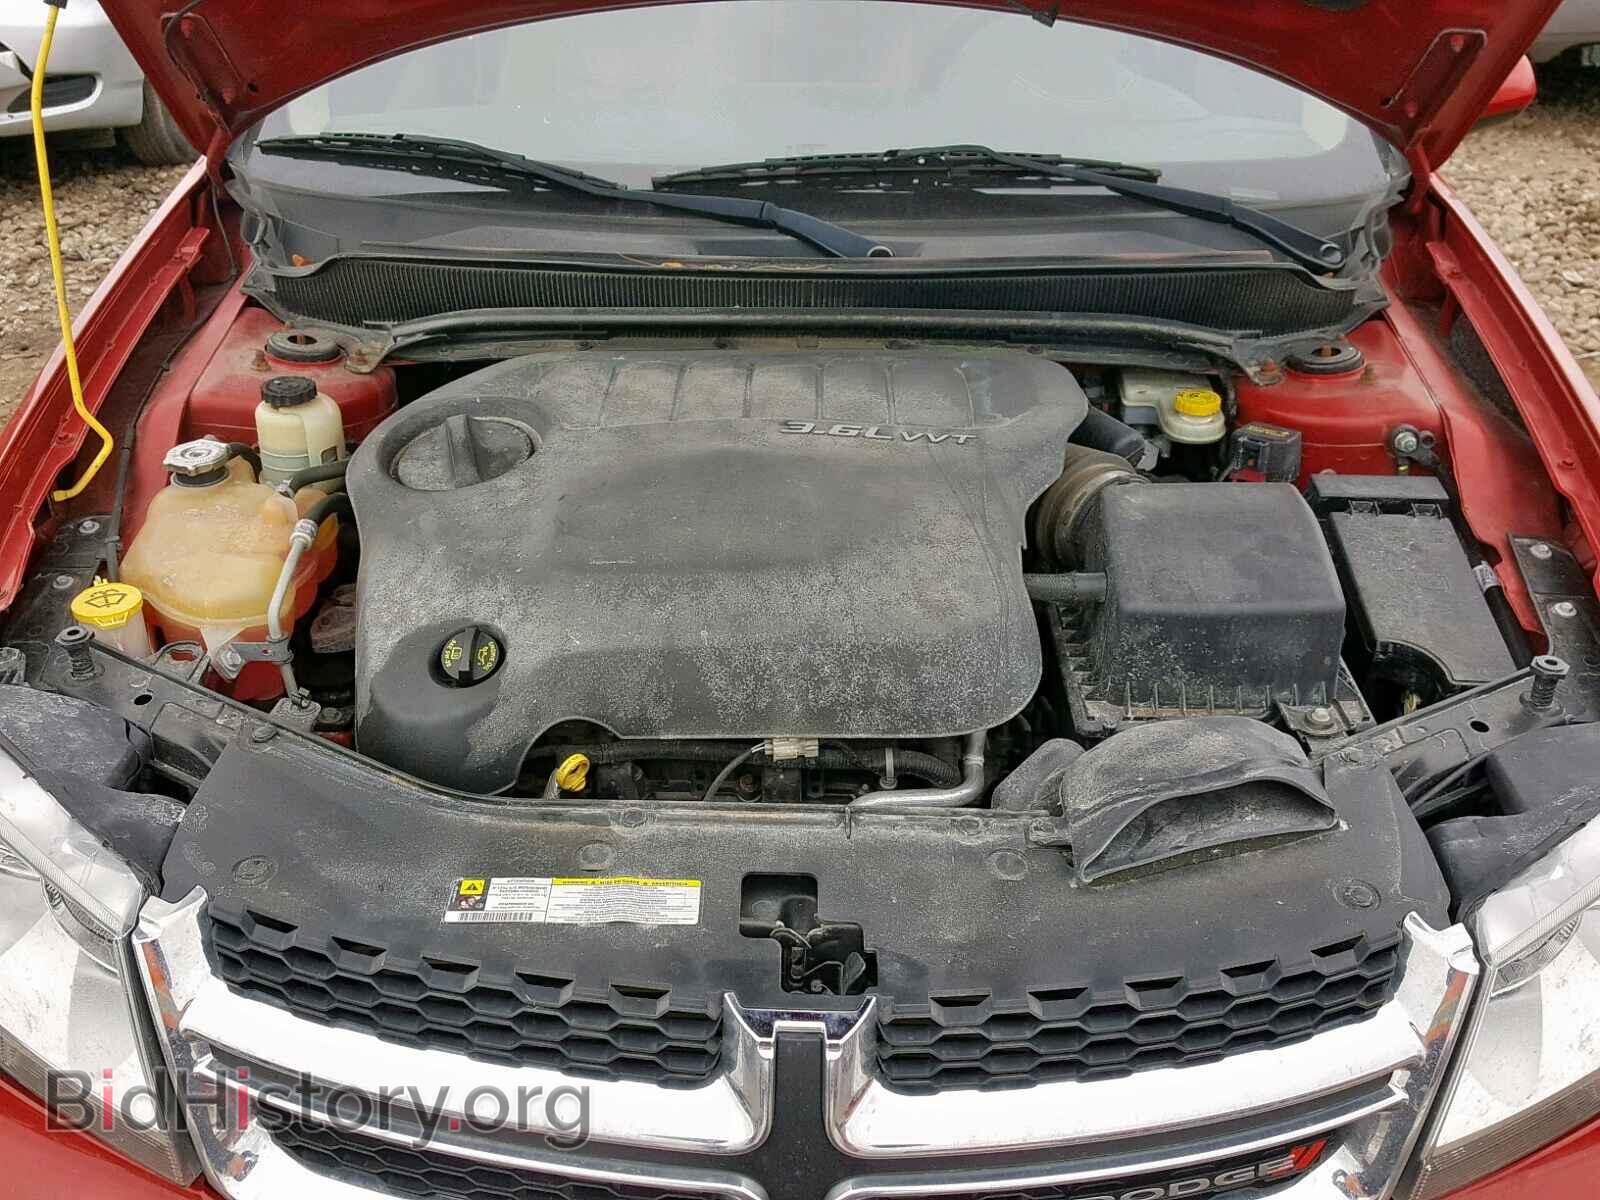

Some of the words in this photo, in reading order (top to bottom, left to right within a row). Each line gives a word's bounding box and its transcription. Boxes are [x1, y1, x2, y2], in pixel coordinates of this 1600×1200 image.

[781, 420, 894, 441] 3.6L
[901, 431, 977, 445] VVT
[1071, 1154, 1297, 1200] ODGE
